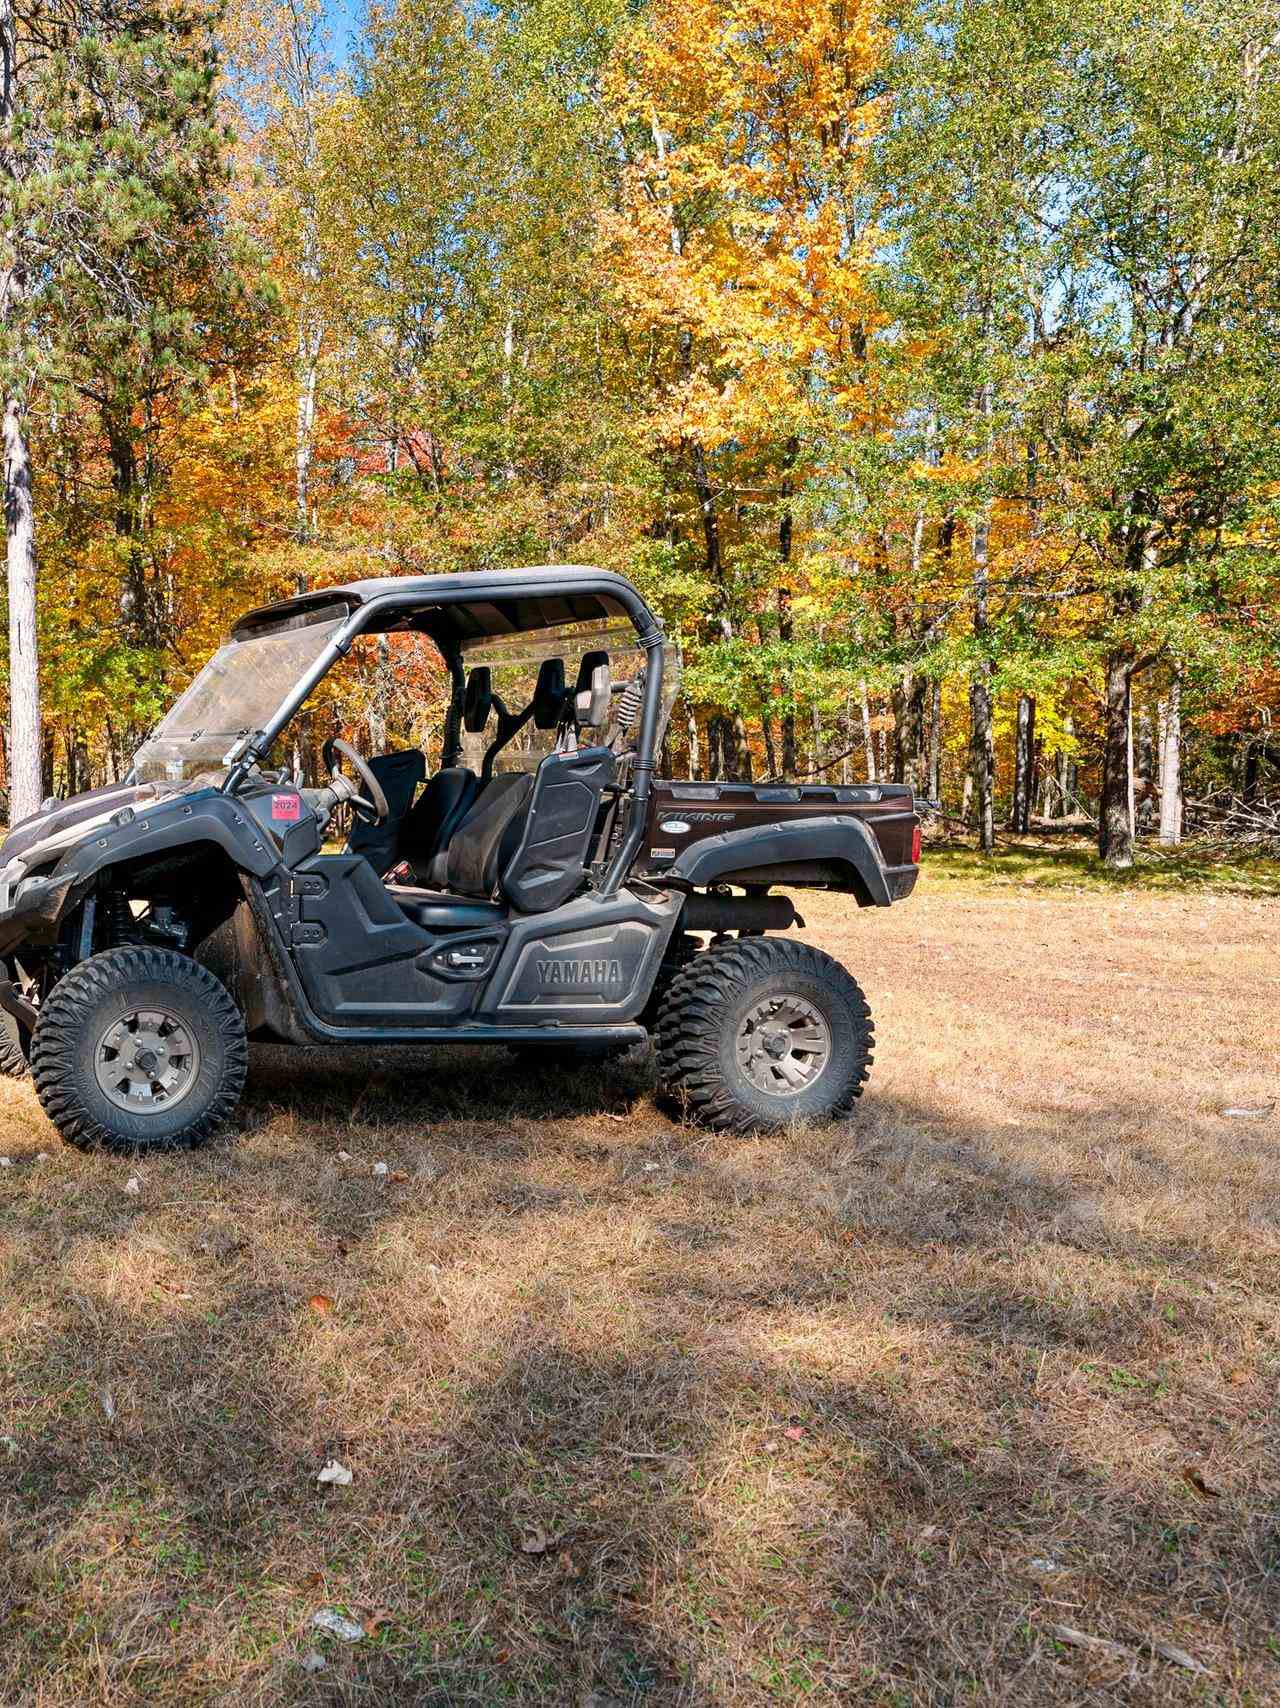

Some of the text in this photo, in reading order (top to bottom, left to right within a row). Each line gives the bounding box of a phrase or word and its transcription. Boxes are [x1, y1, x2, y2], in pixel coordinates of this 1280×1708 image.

[273, 799, 298, 809] 2024
[656, 811, 736, 823] VIKING
[535, 959, 623, 984] YAMAHA
